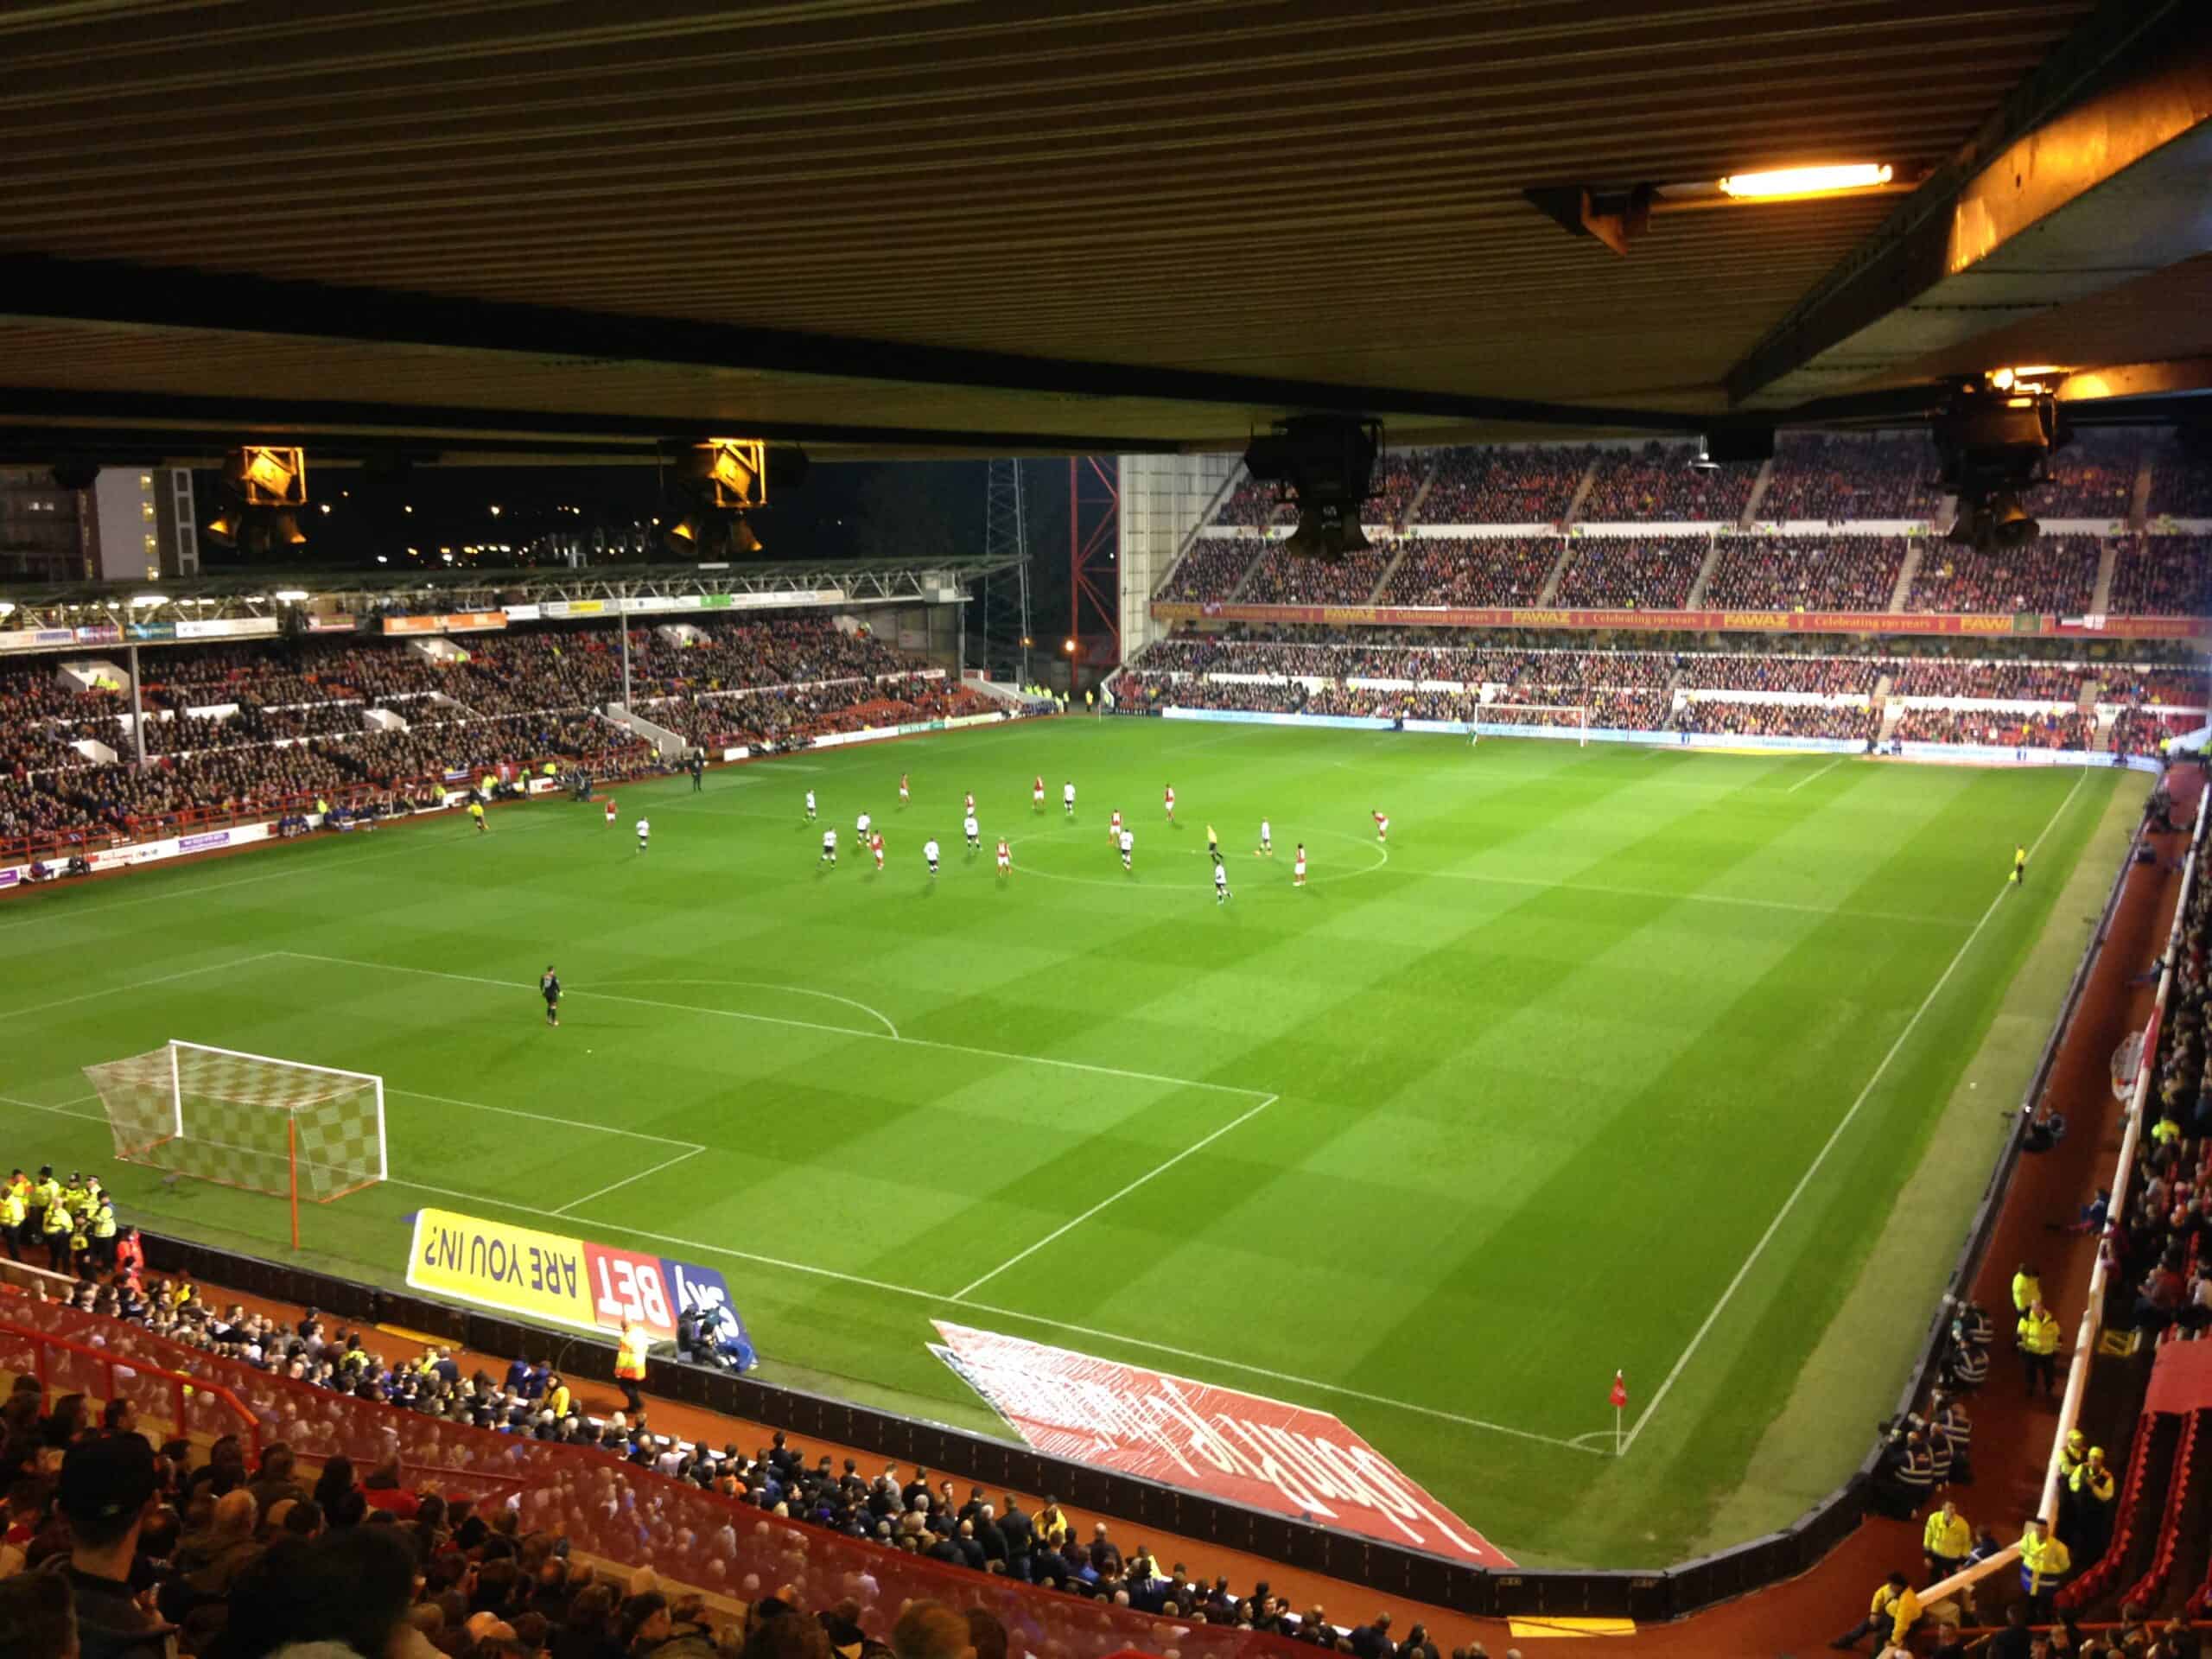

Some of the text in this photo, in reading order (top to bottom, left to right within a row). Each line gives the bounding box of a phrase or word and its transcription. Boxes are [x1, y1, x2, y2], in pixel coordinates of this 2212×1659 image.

[1324, 608, 1376, 623] FAWAZ
[1512, 611, 1570, 625] FAWAZ
[1592, 613, 1652, 626] Celebrating
[1724, 613, 1789, 629] FAWAZ
[1814, 616, 1878, 630] Celebrating
[1961, 615, 2012, 632] FAWA
[425, 1226, 577, 1299] ARE YOU IN?
[598, 1255, 671, 1328] BET
[1145, 1377, 1339, 1518] Pye
[1236, 1414, 1482, 1554] John
